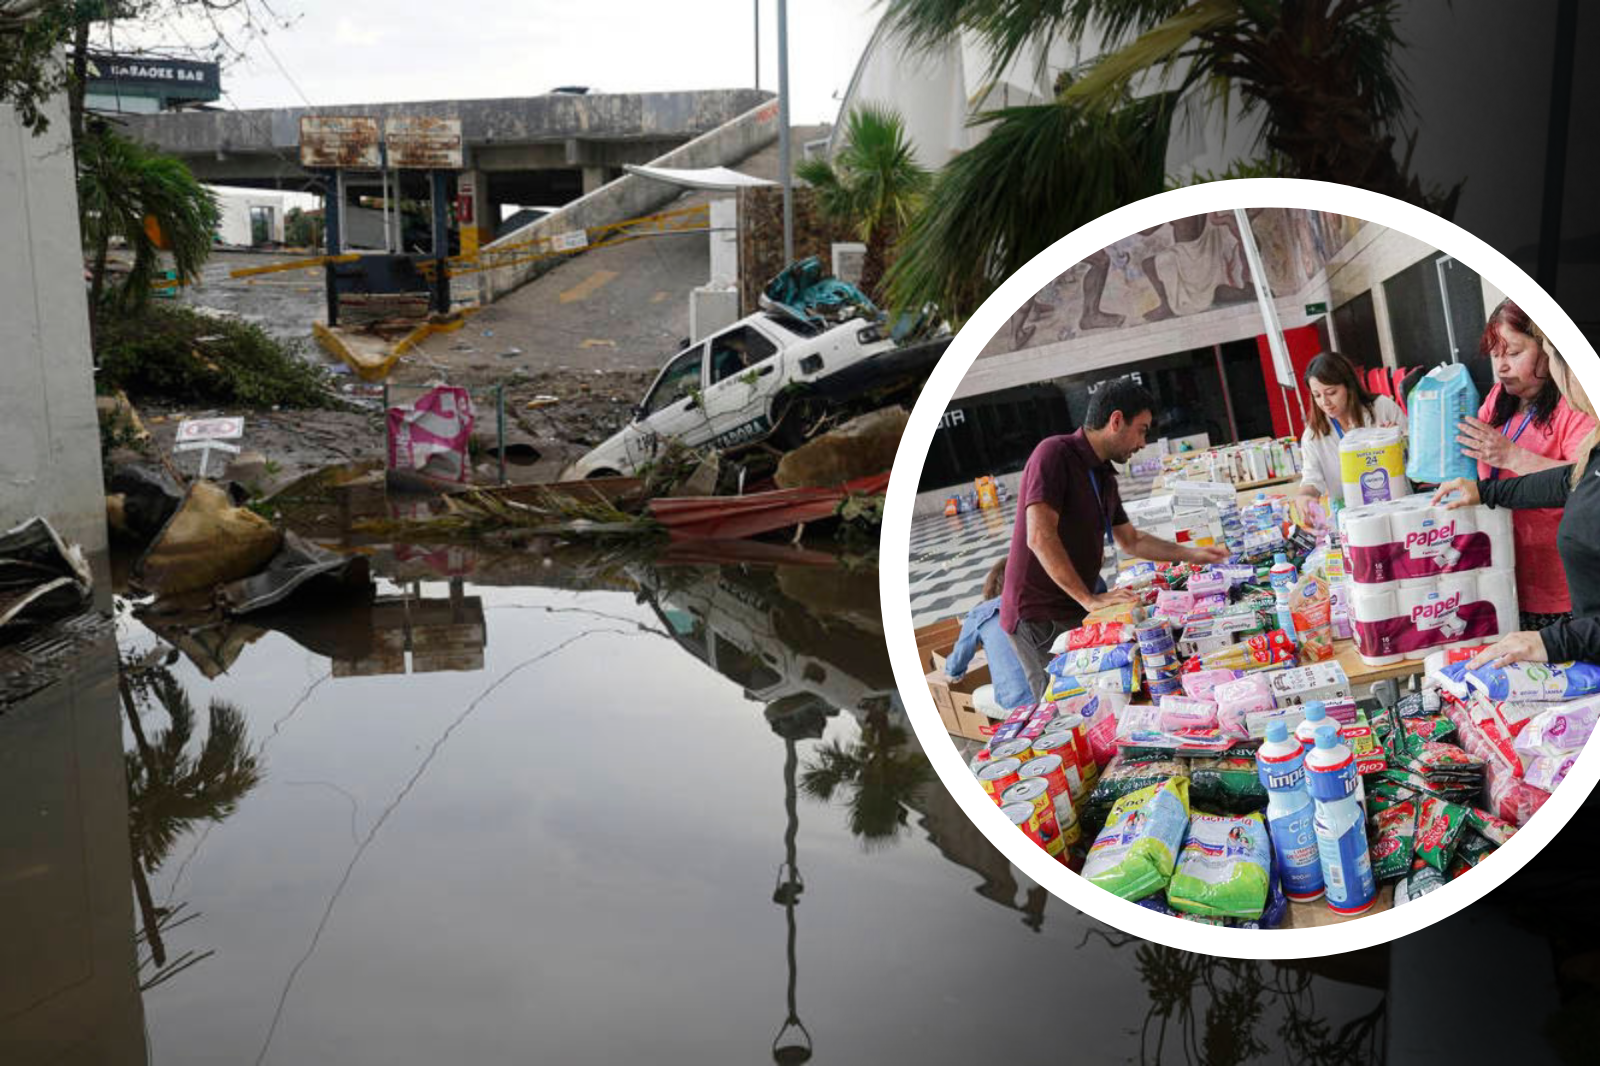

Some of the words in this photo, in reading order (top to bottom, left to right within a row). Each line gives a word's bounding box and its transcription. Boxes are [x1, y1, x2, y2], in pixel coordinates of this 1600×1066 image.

[1405, 519, 1456, 549] Papel
[1411, 591, 1460, 622] Papel
[1358, 761, 1385, 773] Colg
